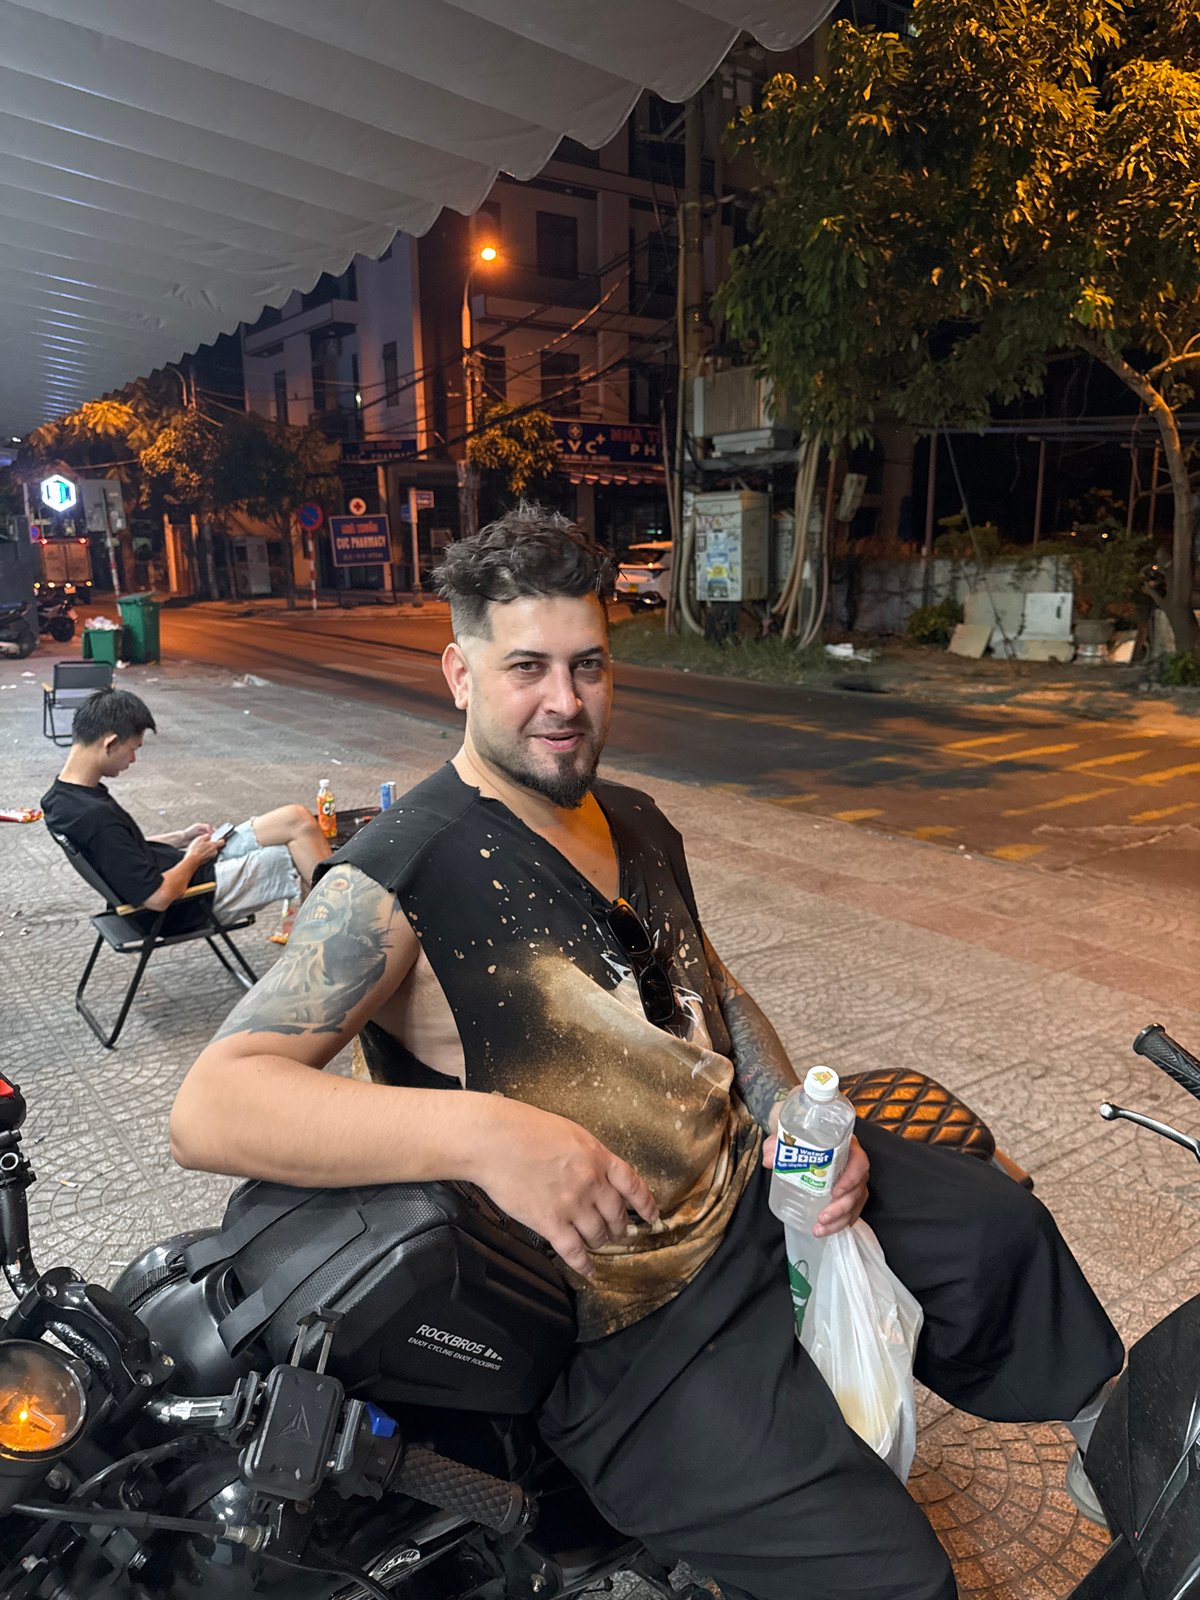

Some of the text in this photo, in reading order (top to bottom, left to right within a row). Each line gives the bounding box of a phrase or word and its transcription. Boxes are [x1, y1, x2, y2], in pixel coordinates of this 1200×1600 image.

[778, 1144, 829, 1163] Boost
[800, 1149, 825, 1157] Water
[415, 1324, 486, 1354] ROCKBROS
[408, 1337, 501, 1370] ENJOY CYCLING ENJOY ROCKBROS
